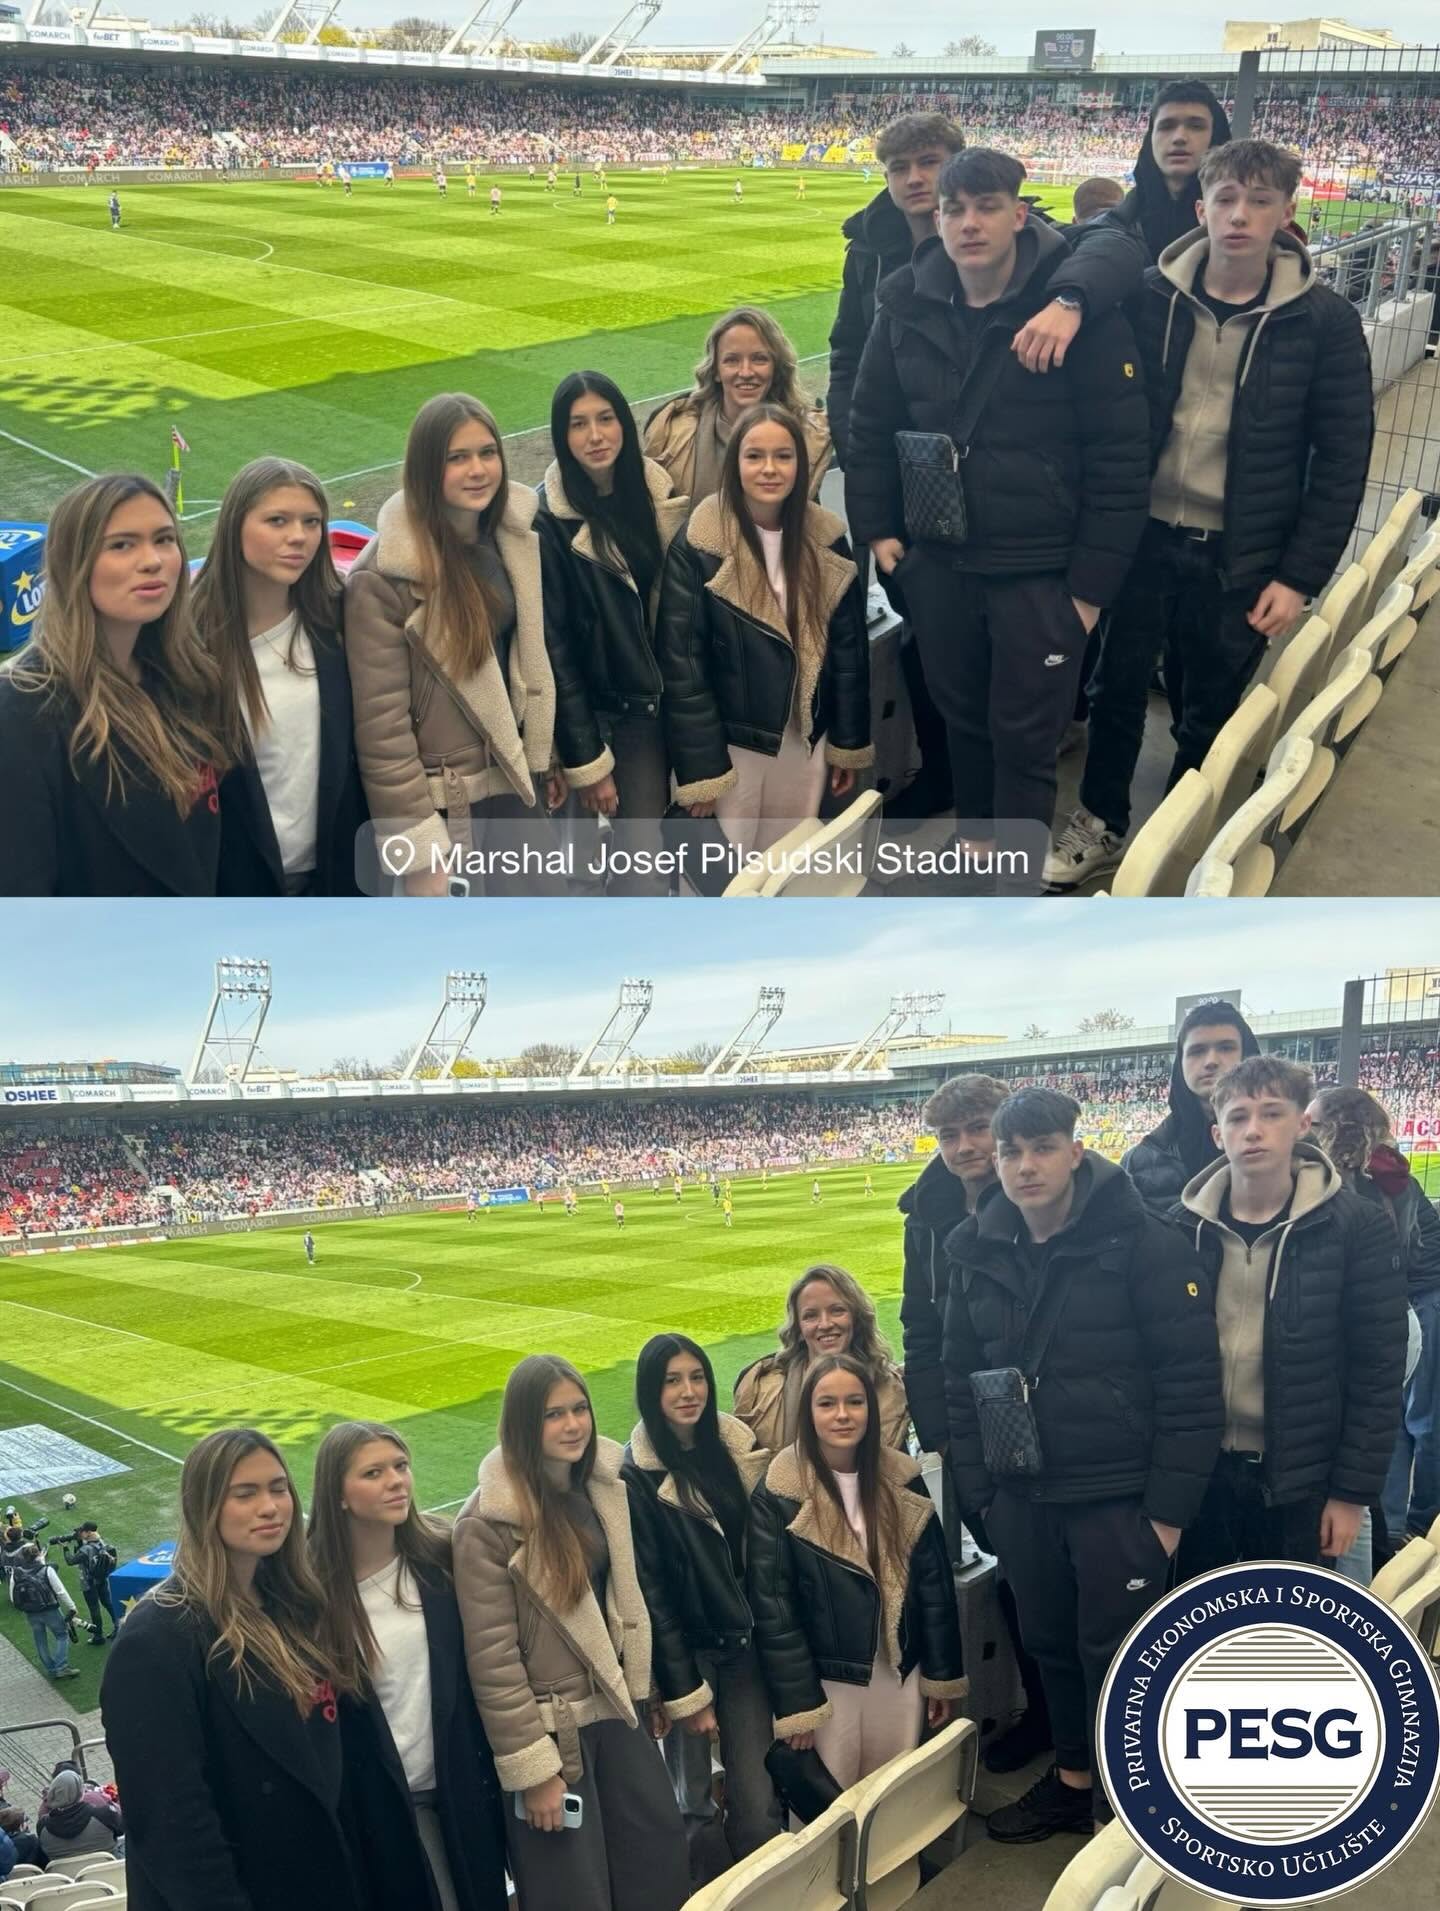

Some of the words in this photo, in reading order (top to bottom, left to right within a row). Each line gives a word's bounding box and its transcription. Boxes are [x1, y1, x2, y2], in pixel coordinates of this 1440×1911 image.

[58, 172, 121, 184] COMARCH
[147, 170, 201, 182] COMARCH
[215, 169, 265, 181] CMARCH
[5, 1089, 57, 1102] OSHEE
[73, 1090, 117, 1098] COMARCH
[189, 1087, 227, 1096] COMARCH
[302, 1209, 353, 1224] COMARCH
[223, 1217, 279, 1232] COMARCH
[64, 1231, 132, 1247] COMARCH
